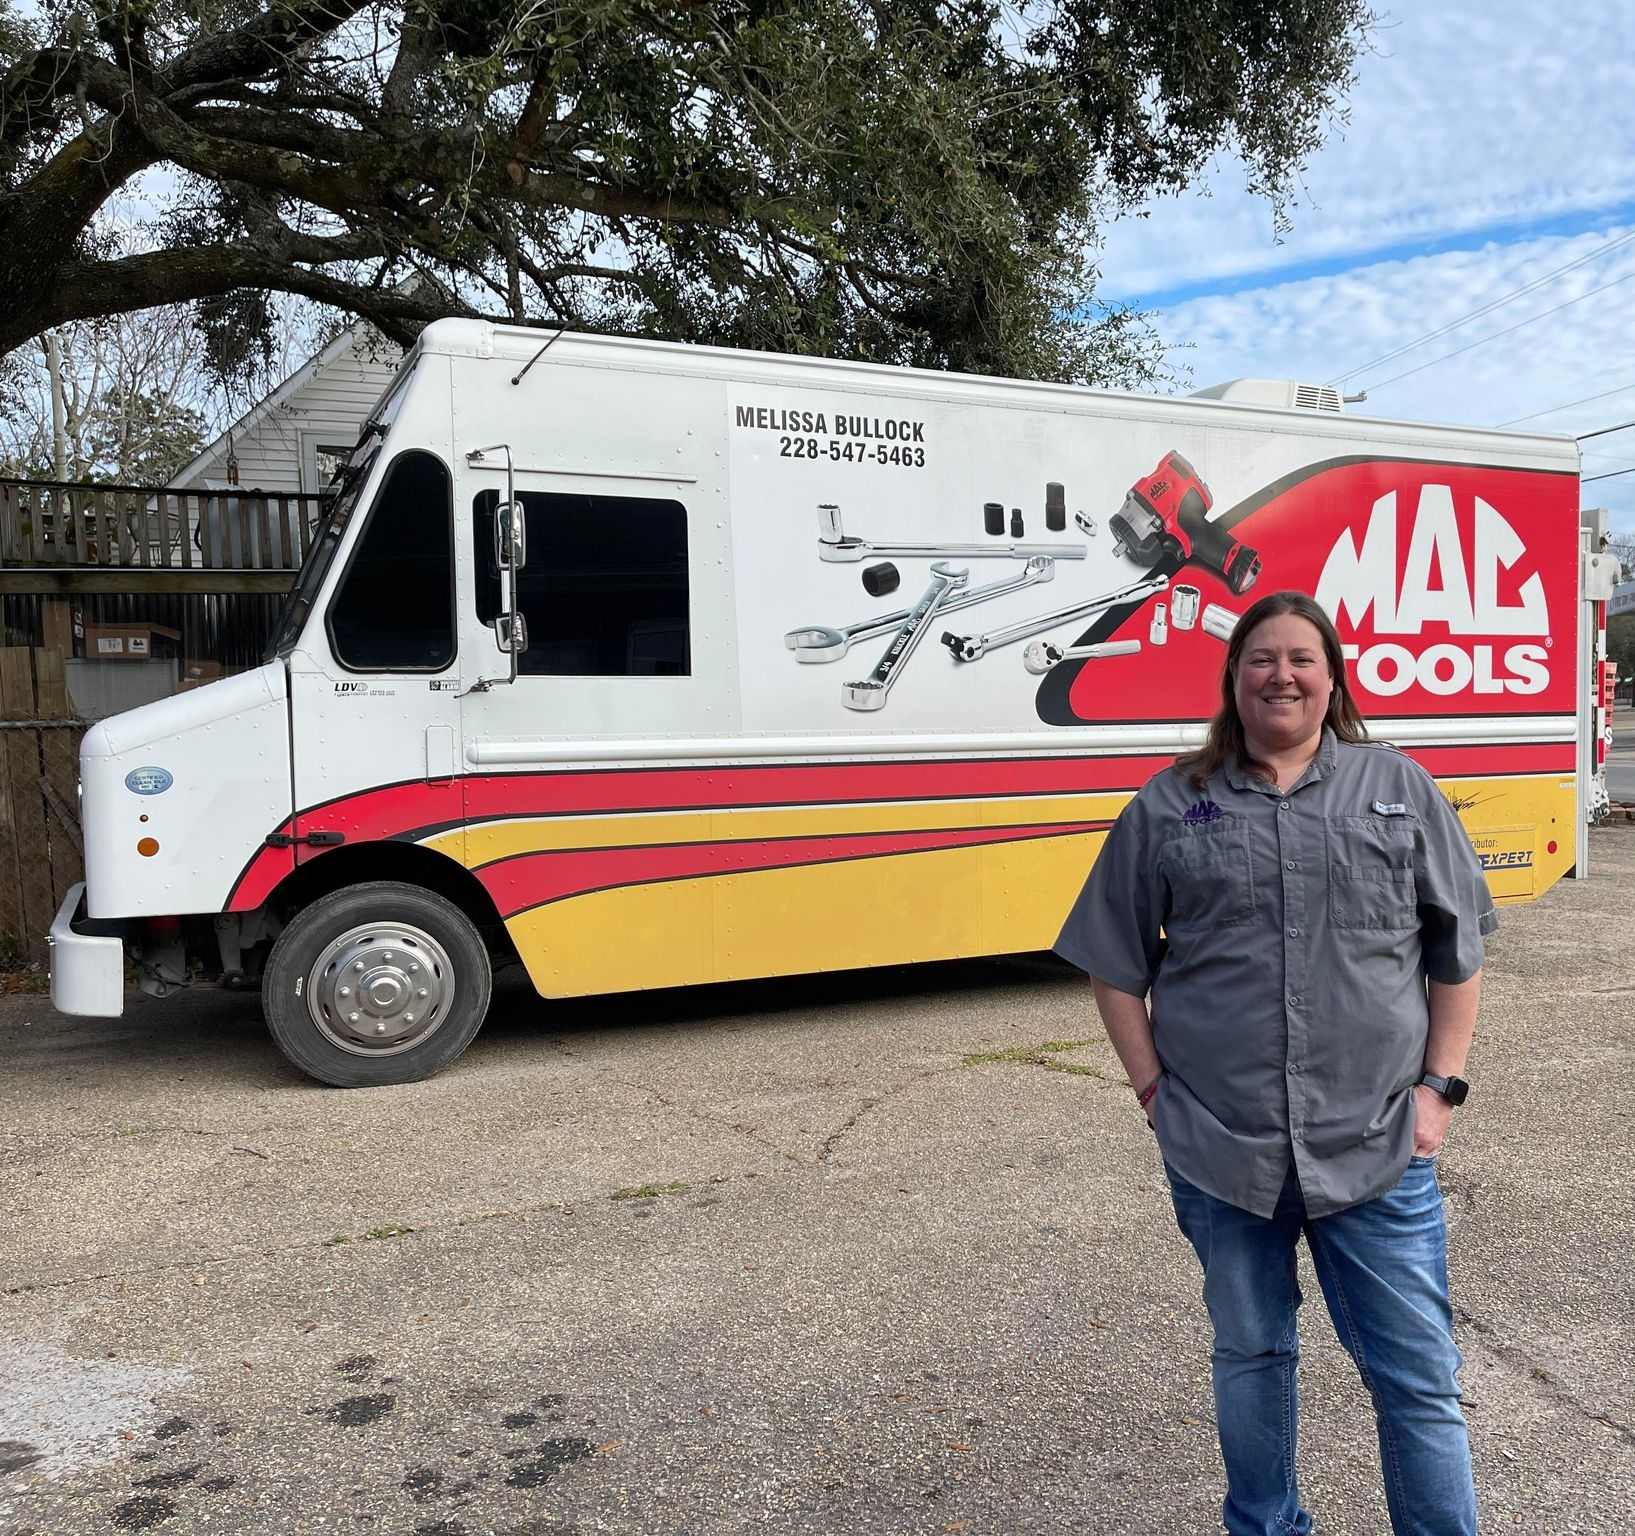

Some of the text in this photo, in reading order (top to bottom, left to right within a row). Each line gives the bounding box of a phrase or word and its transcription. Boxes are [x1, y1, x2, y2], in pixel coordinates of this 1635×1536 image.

[735, 405, 925, 443] MELISSA BULLOCK
[779, 436, 926, 468] 228-547-5463
[1150, 481, 1167, 499] MAC
[1314, 484, 1550, 636] MAC
[879, 661, 893, 673] 3/4
[1182, 799, 1222, 819] MAC
[1470, 838, 1498, 849] ributor:
